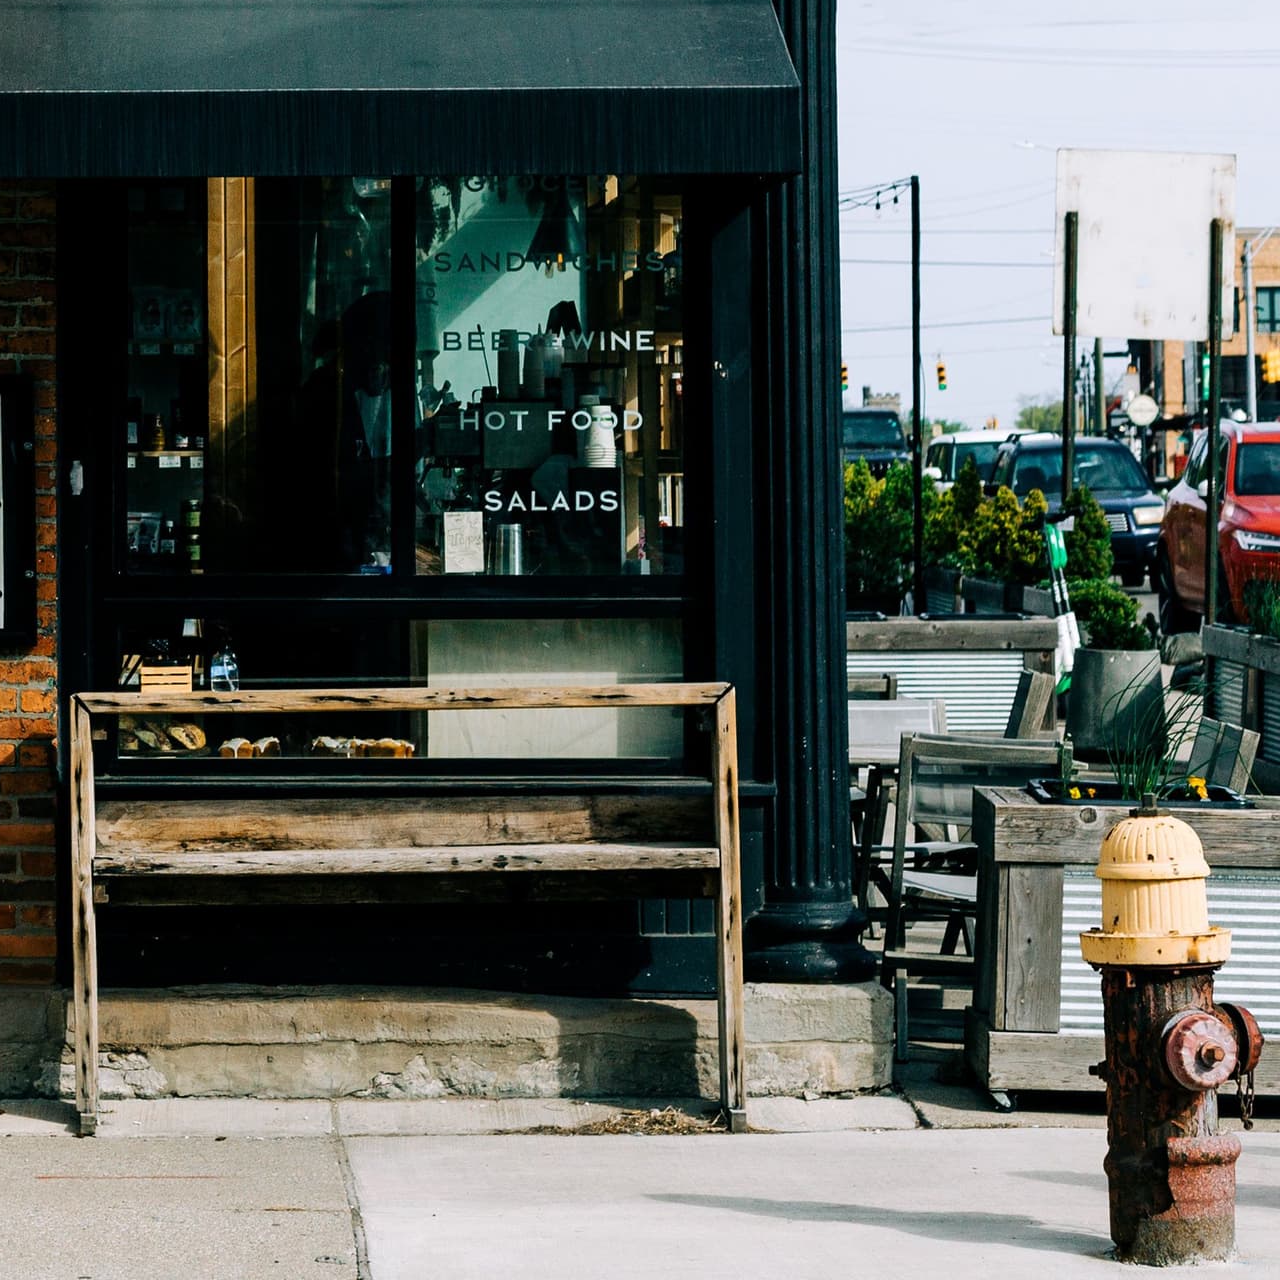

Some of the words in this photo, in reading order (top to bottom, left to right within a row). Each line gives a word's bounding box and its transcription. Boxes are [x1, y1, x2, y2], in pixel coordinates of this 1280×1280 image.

[434, 252, 666, 272] SANDWICHES
[443, 331, 535, 351] BEER
[569, 330, 655, 351] WINE
[460, 410, 529, 431] HOT
[547, 410, 644, 431] FOOD
[484, 490, 619, 512] SALADS
